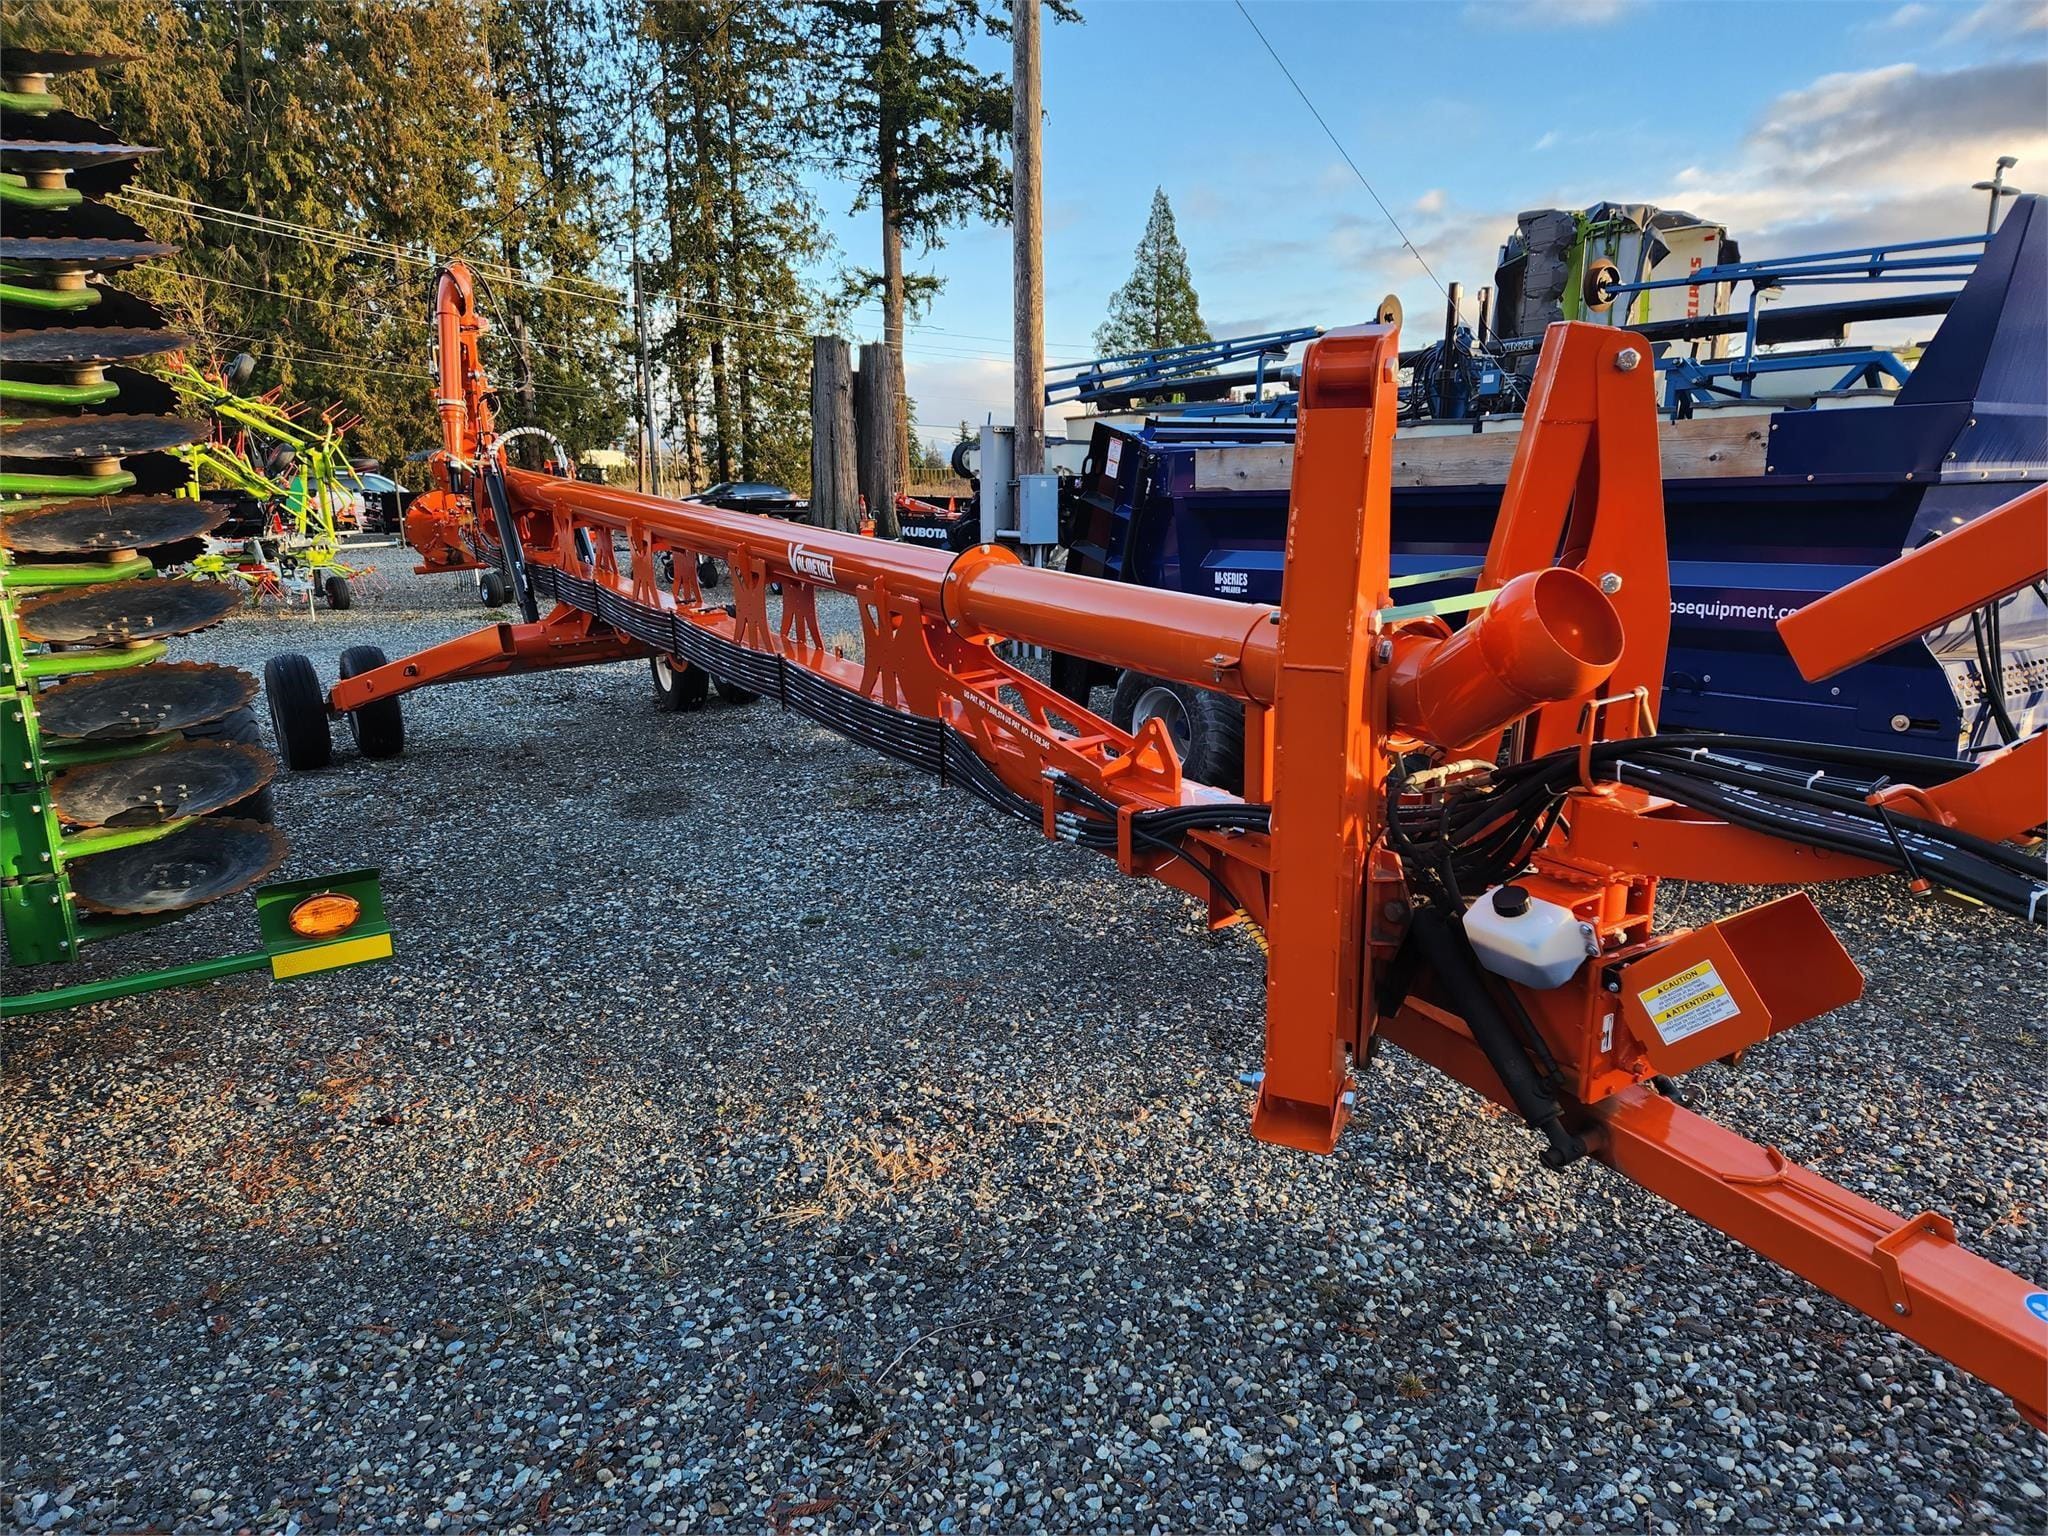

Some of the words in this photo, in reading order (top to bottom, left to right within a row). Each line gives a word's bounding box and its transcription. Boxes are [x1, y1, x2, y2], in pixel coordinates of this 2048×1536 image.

[1687, 257, 1702, 320] CLAS
[902, 526, 948, 539] KUBOTA
[788, 542, 835, 583] VALMETAL
[1214, 571, 1248, 586] M-SERIES
[1663, 970, 1698, 991] CAUTION
[1672, 991, 1715, 1016] ATTENTION
